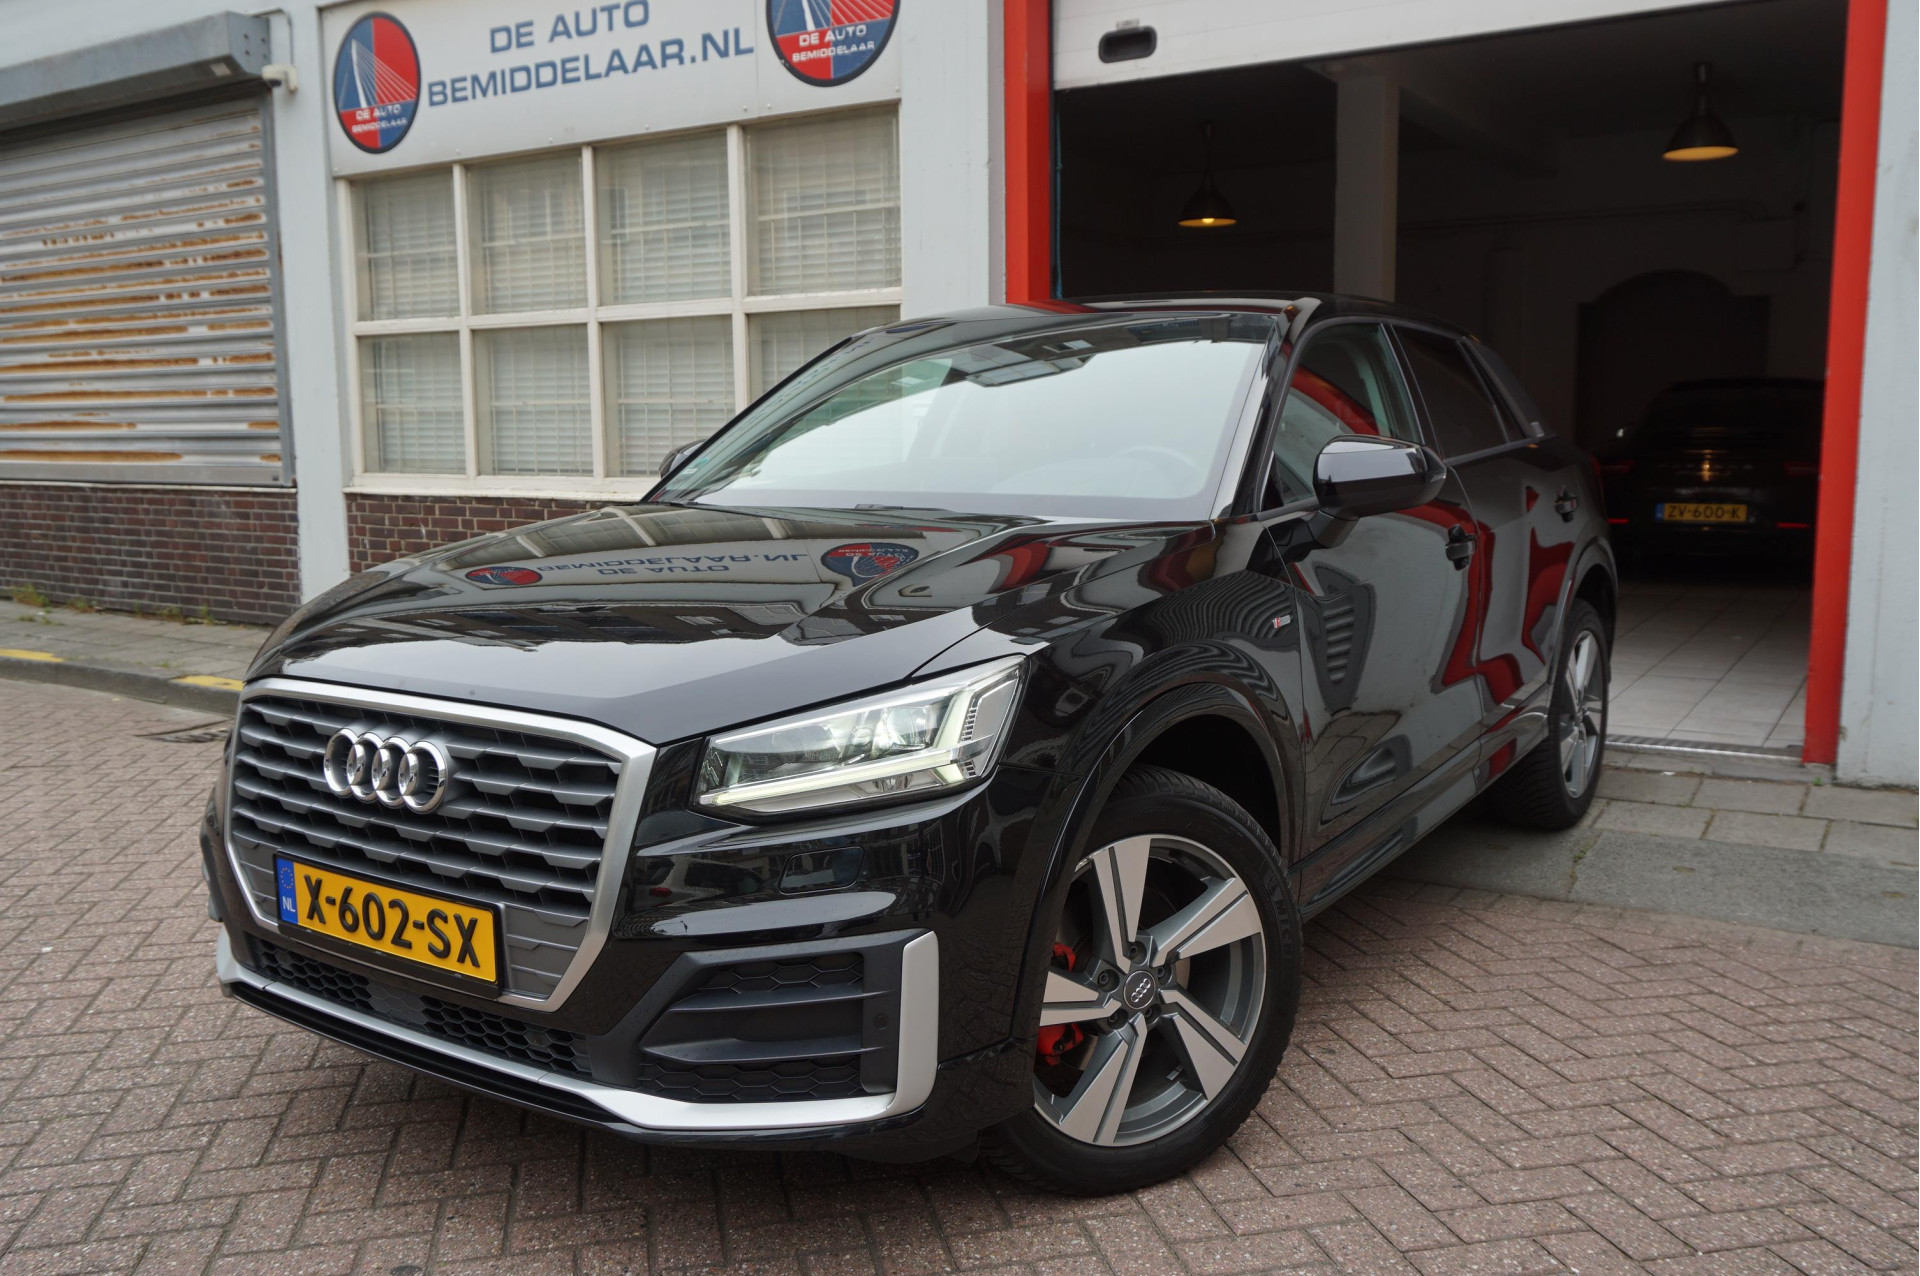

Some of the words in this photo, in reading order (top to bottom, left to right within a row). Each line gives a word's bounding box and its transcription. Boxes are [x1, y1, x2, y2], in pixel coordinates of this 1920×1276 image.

[490, 20, 535, 53] DE
[548, 0, 649, 43] AUTO
[799, 32, 819, 46] DE
[824, 24, 867, 42] AUTO
[792, 40, 875, 62] BEMIDDELAAR
[427, 27, 754, 107] BEMIDDELAAR.NL
[355, 110, 370, 121] DE
[373, 104, 401, 117] AUTO
[1668, 505, 1741, 519] ZV-600-K
[281, 895, 296, 913] NL
[303, 873, 480, 969] X-602-SX
